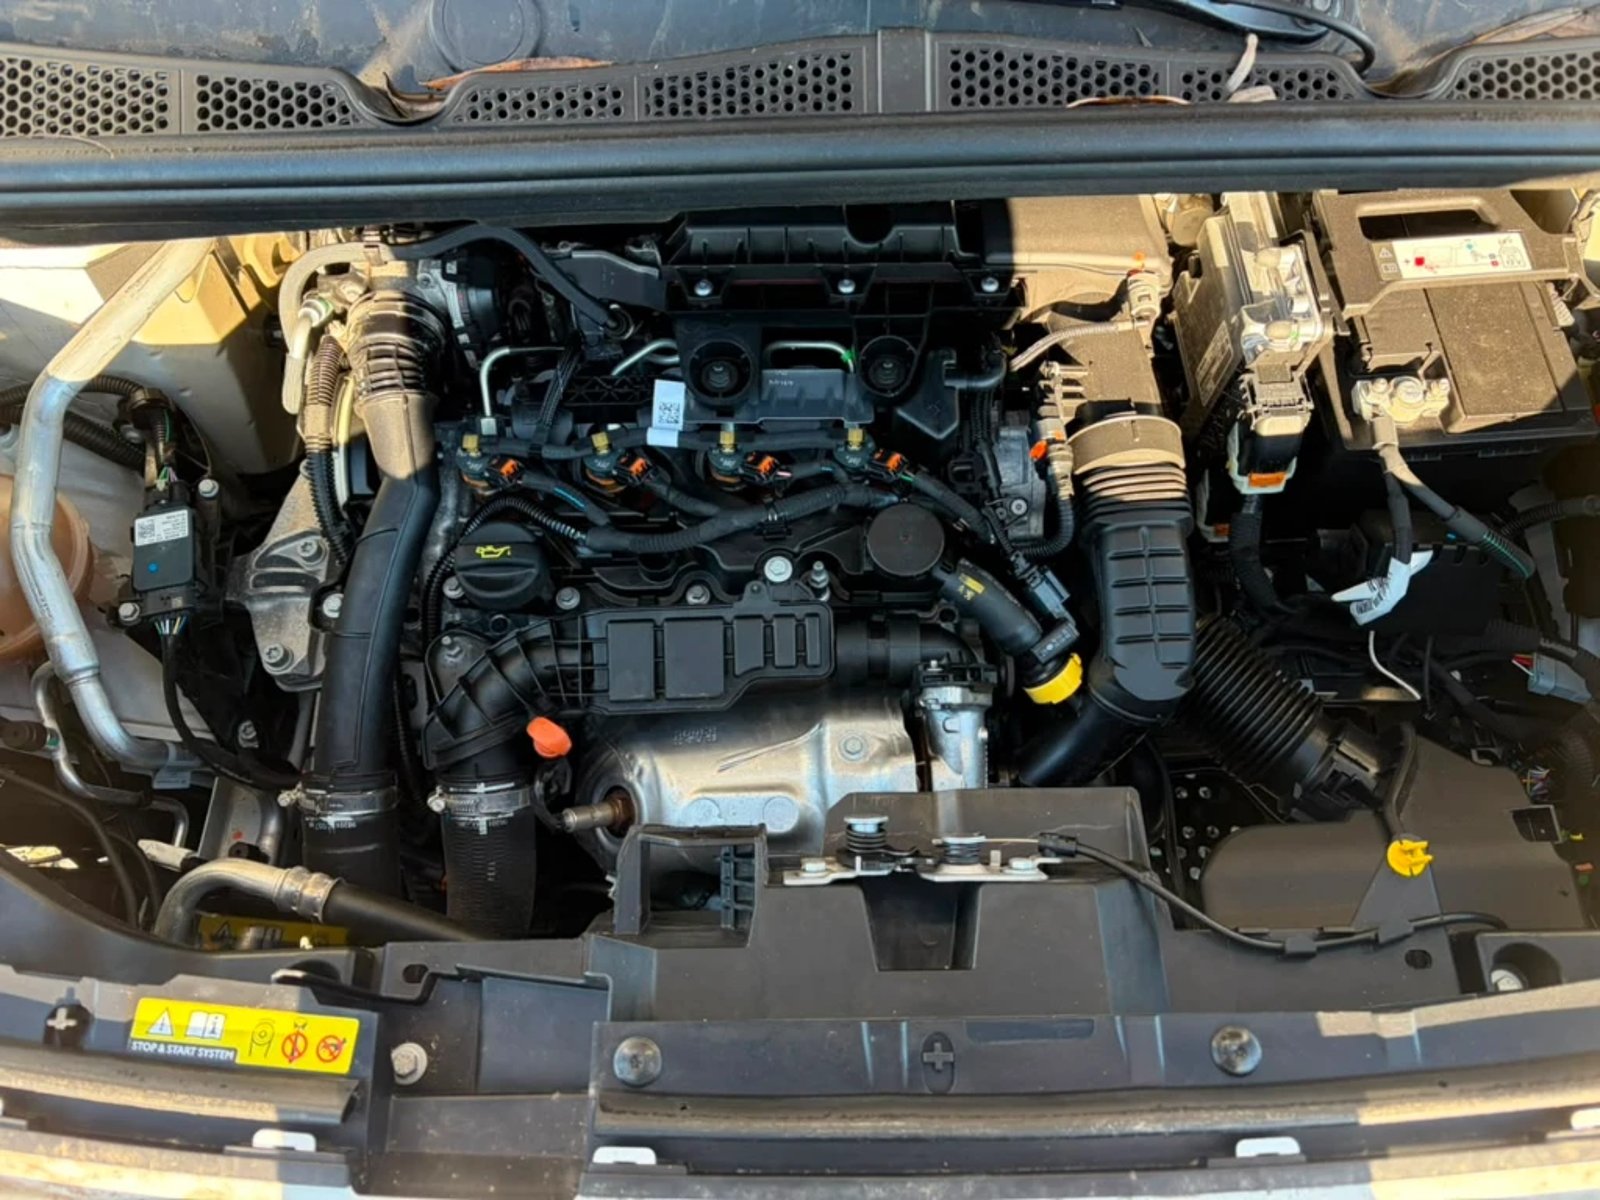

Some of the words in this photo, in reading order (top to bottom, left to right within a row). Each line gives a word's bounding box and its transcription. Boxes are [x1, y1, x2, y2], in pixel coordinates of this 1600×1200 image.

[131, 1040, 158, 1052] STOP
[158, 1044, 165, 1054] &
[167, 1045, 198, 1056] START
[198, 1048, 234, 1060] SYSTEM
